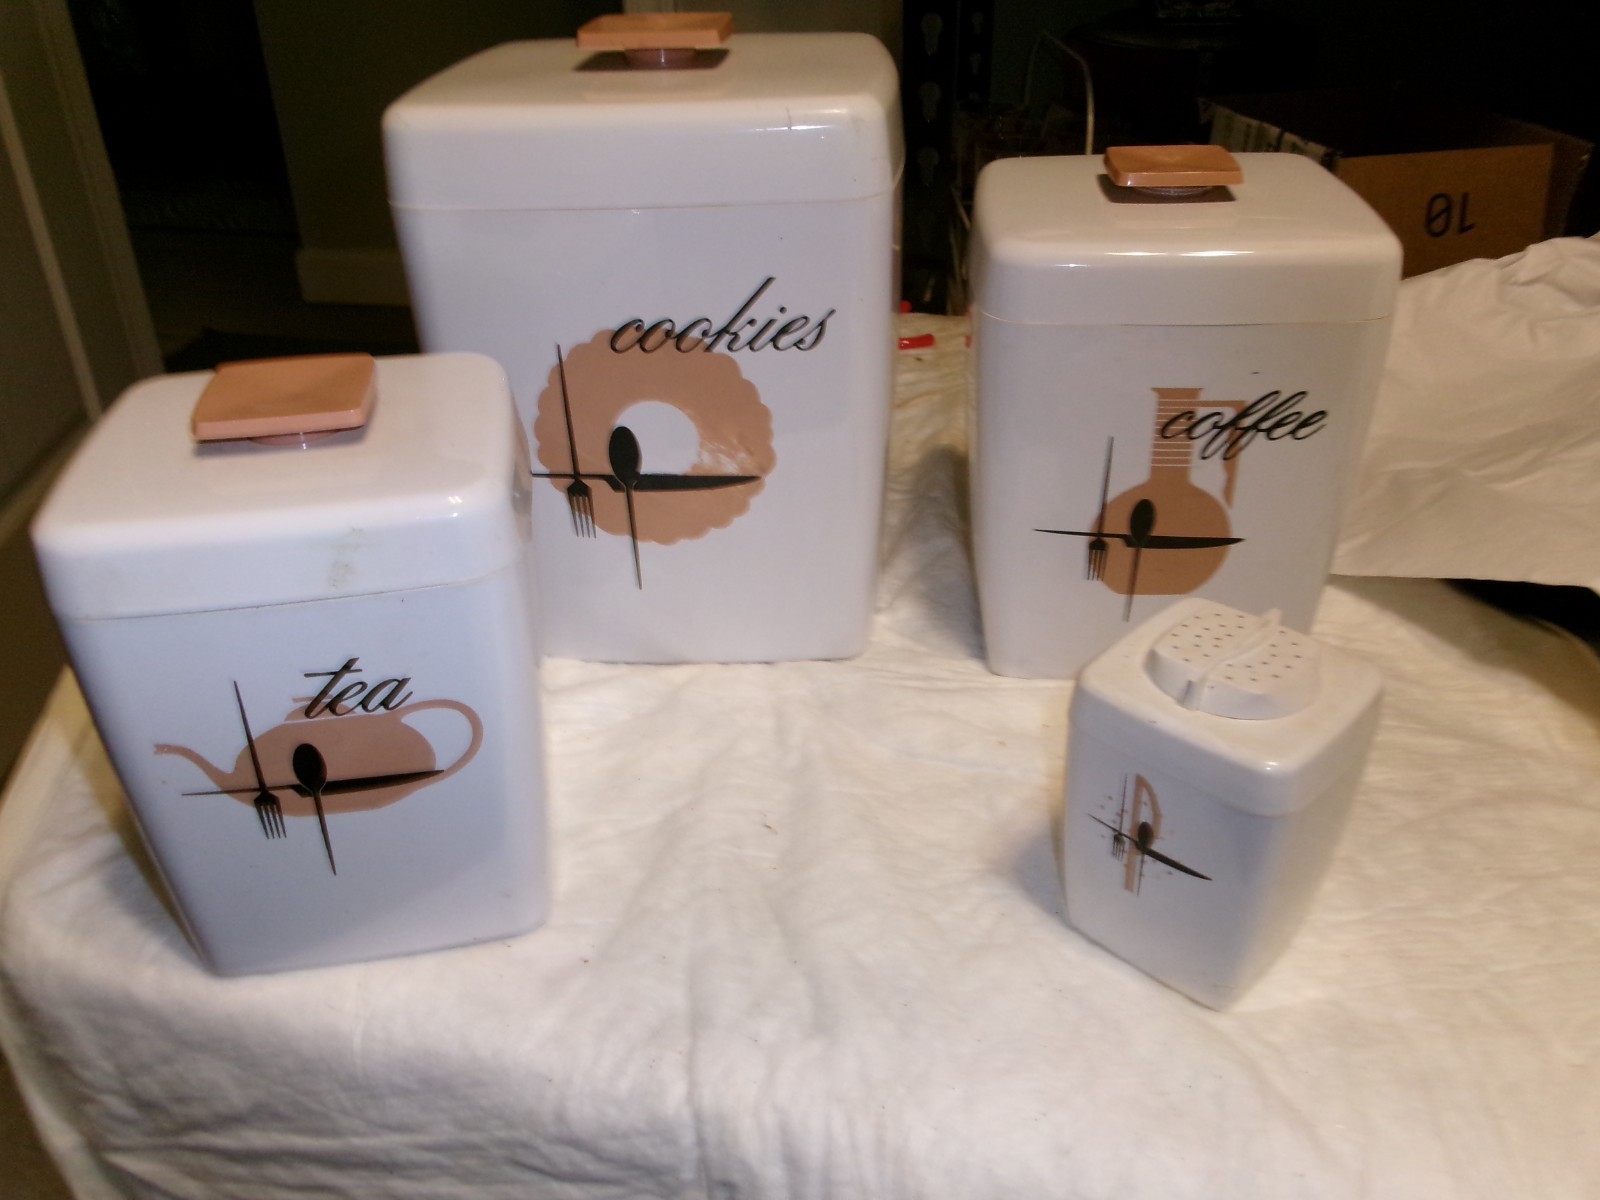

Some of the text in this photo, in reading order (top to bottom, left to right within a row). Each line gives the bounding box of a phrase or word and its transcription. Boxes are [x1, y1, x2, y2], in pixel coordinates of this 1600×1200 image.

[610, 277, 836, 354] cookies
[1161, 390, 1328, 460] coffee
[304, 657, 413, 719] tea
